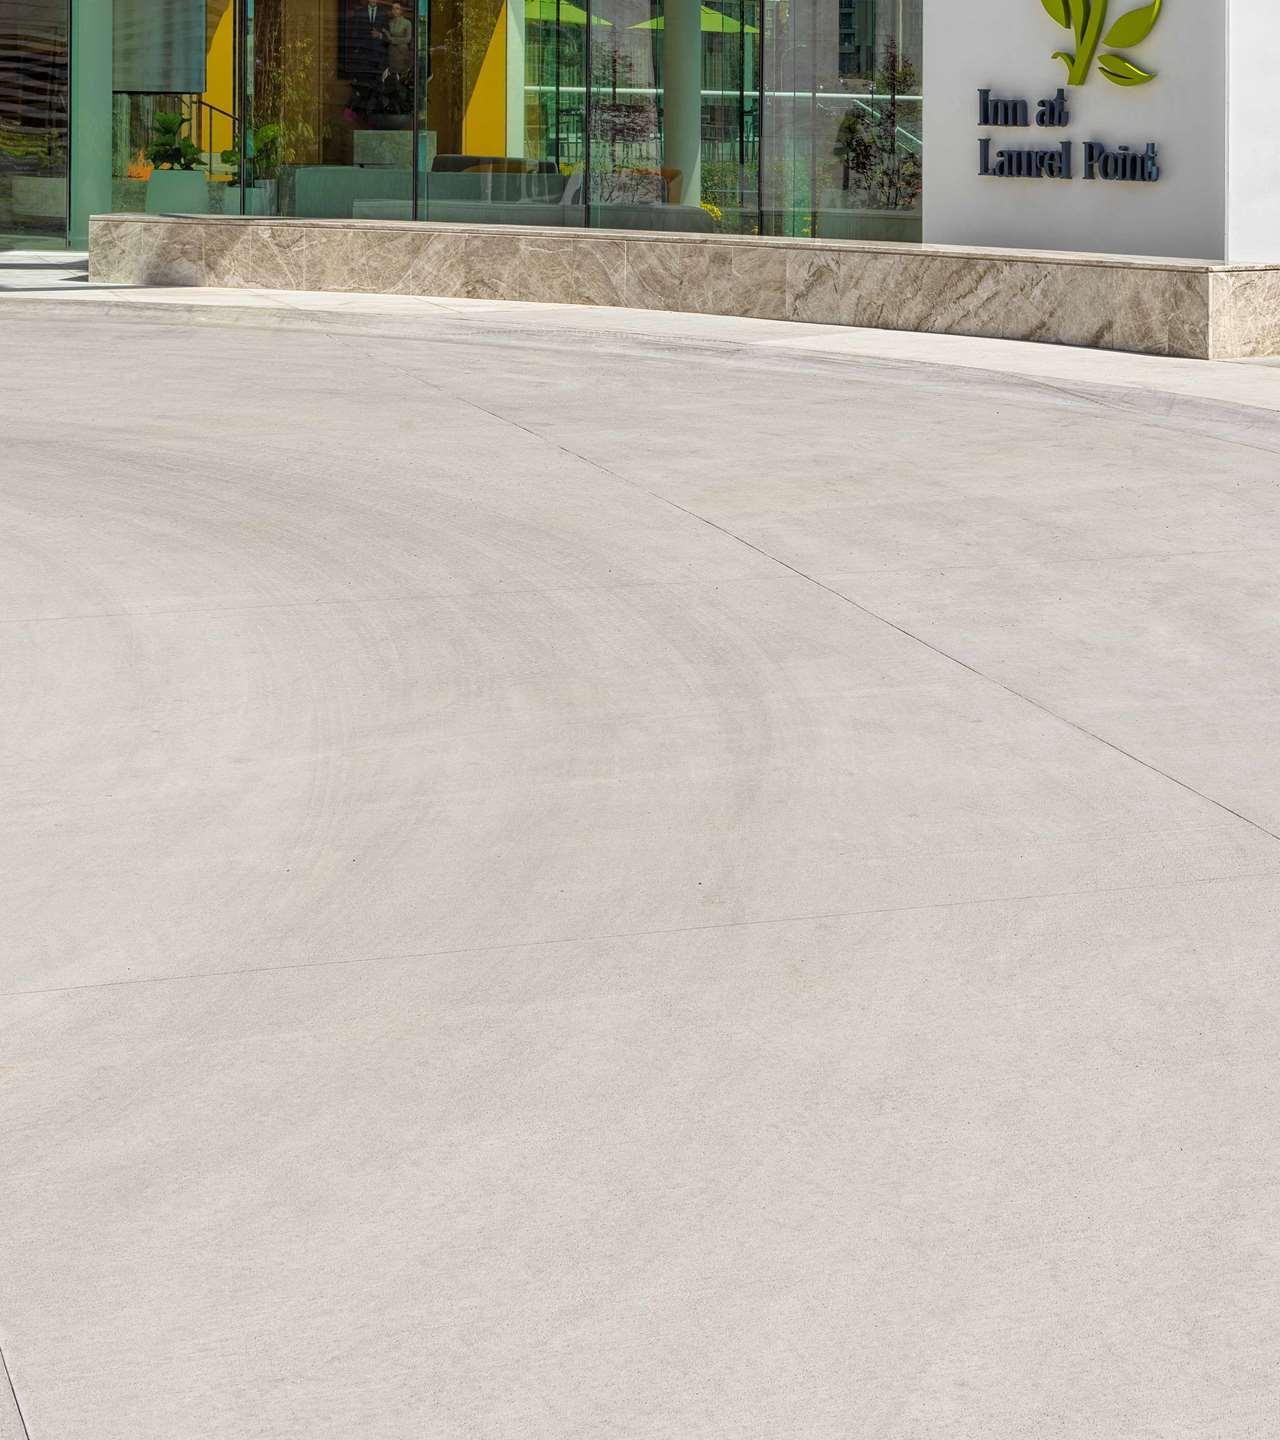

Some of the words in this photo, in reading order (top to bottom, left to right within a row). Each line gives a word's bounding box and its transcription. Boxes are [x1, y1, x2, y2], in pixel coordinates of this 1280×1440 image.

[977, 88, 1030, 127] Inn
[1036, 88, 1070, 127] at
[977, 138, 1072, 179] Laurel
[1082, 142, 1160, 181] Point
